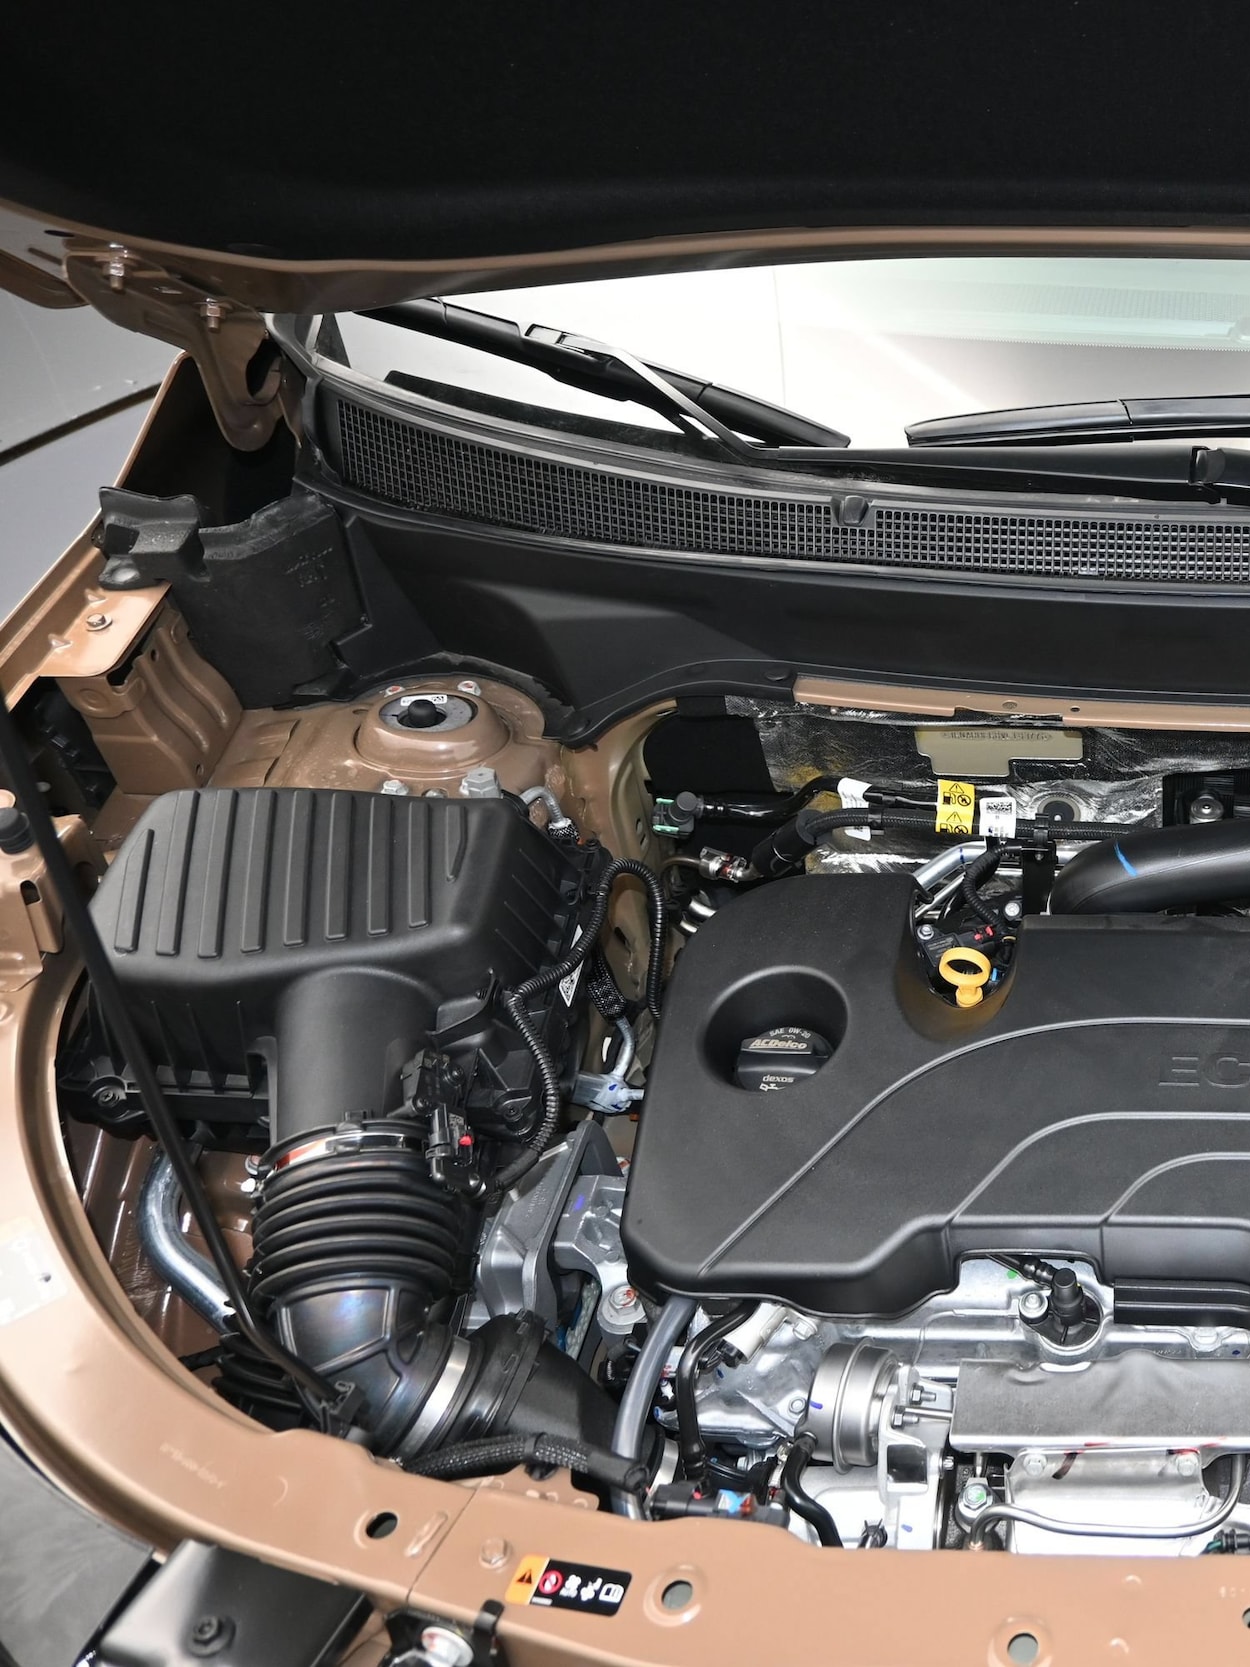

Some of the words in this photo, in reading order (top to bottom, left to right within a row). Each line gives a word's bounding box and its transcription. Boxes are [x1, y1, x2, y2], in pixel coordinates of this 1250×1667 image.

[769, 1028, 785, 1037] SAE
[788, 1027, 811, 1039] 0W-20
[748, 1039, 808, 1050] ACDelco
[762, 1074, 796, 1083] dexos
